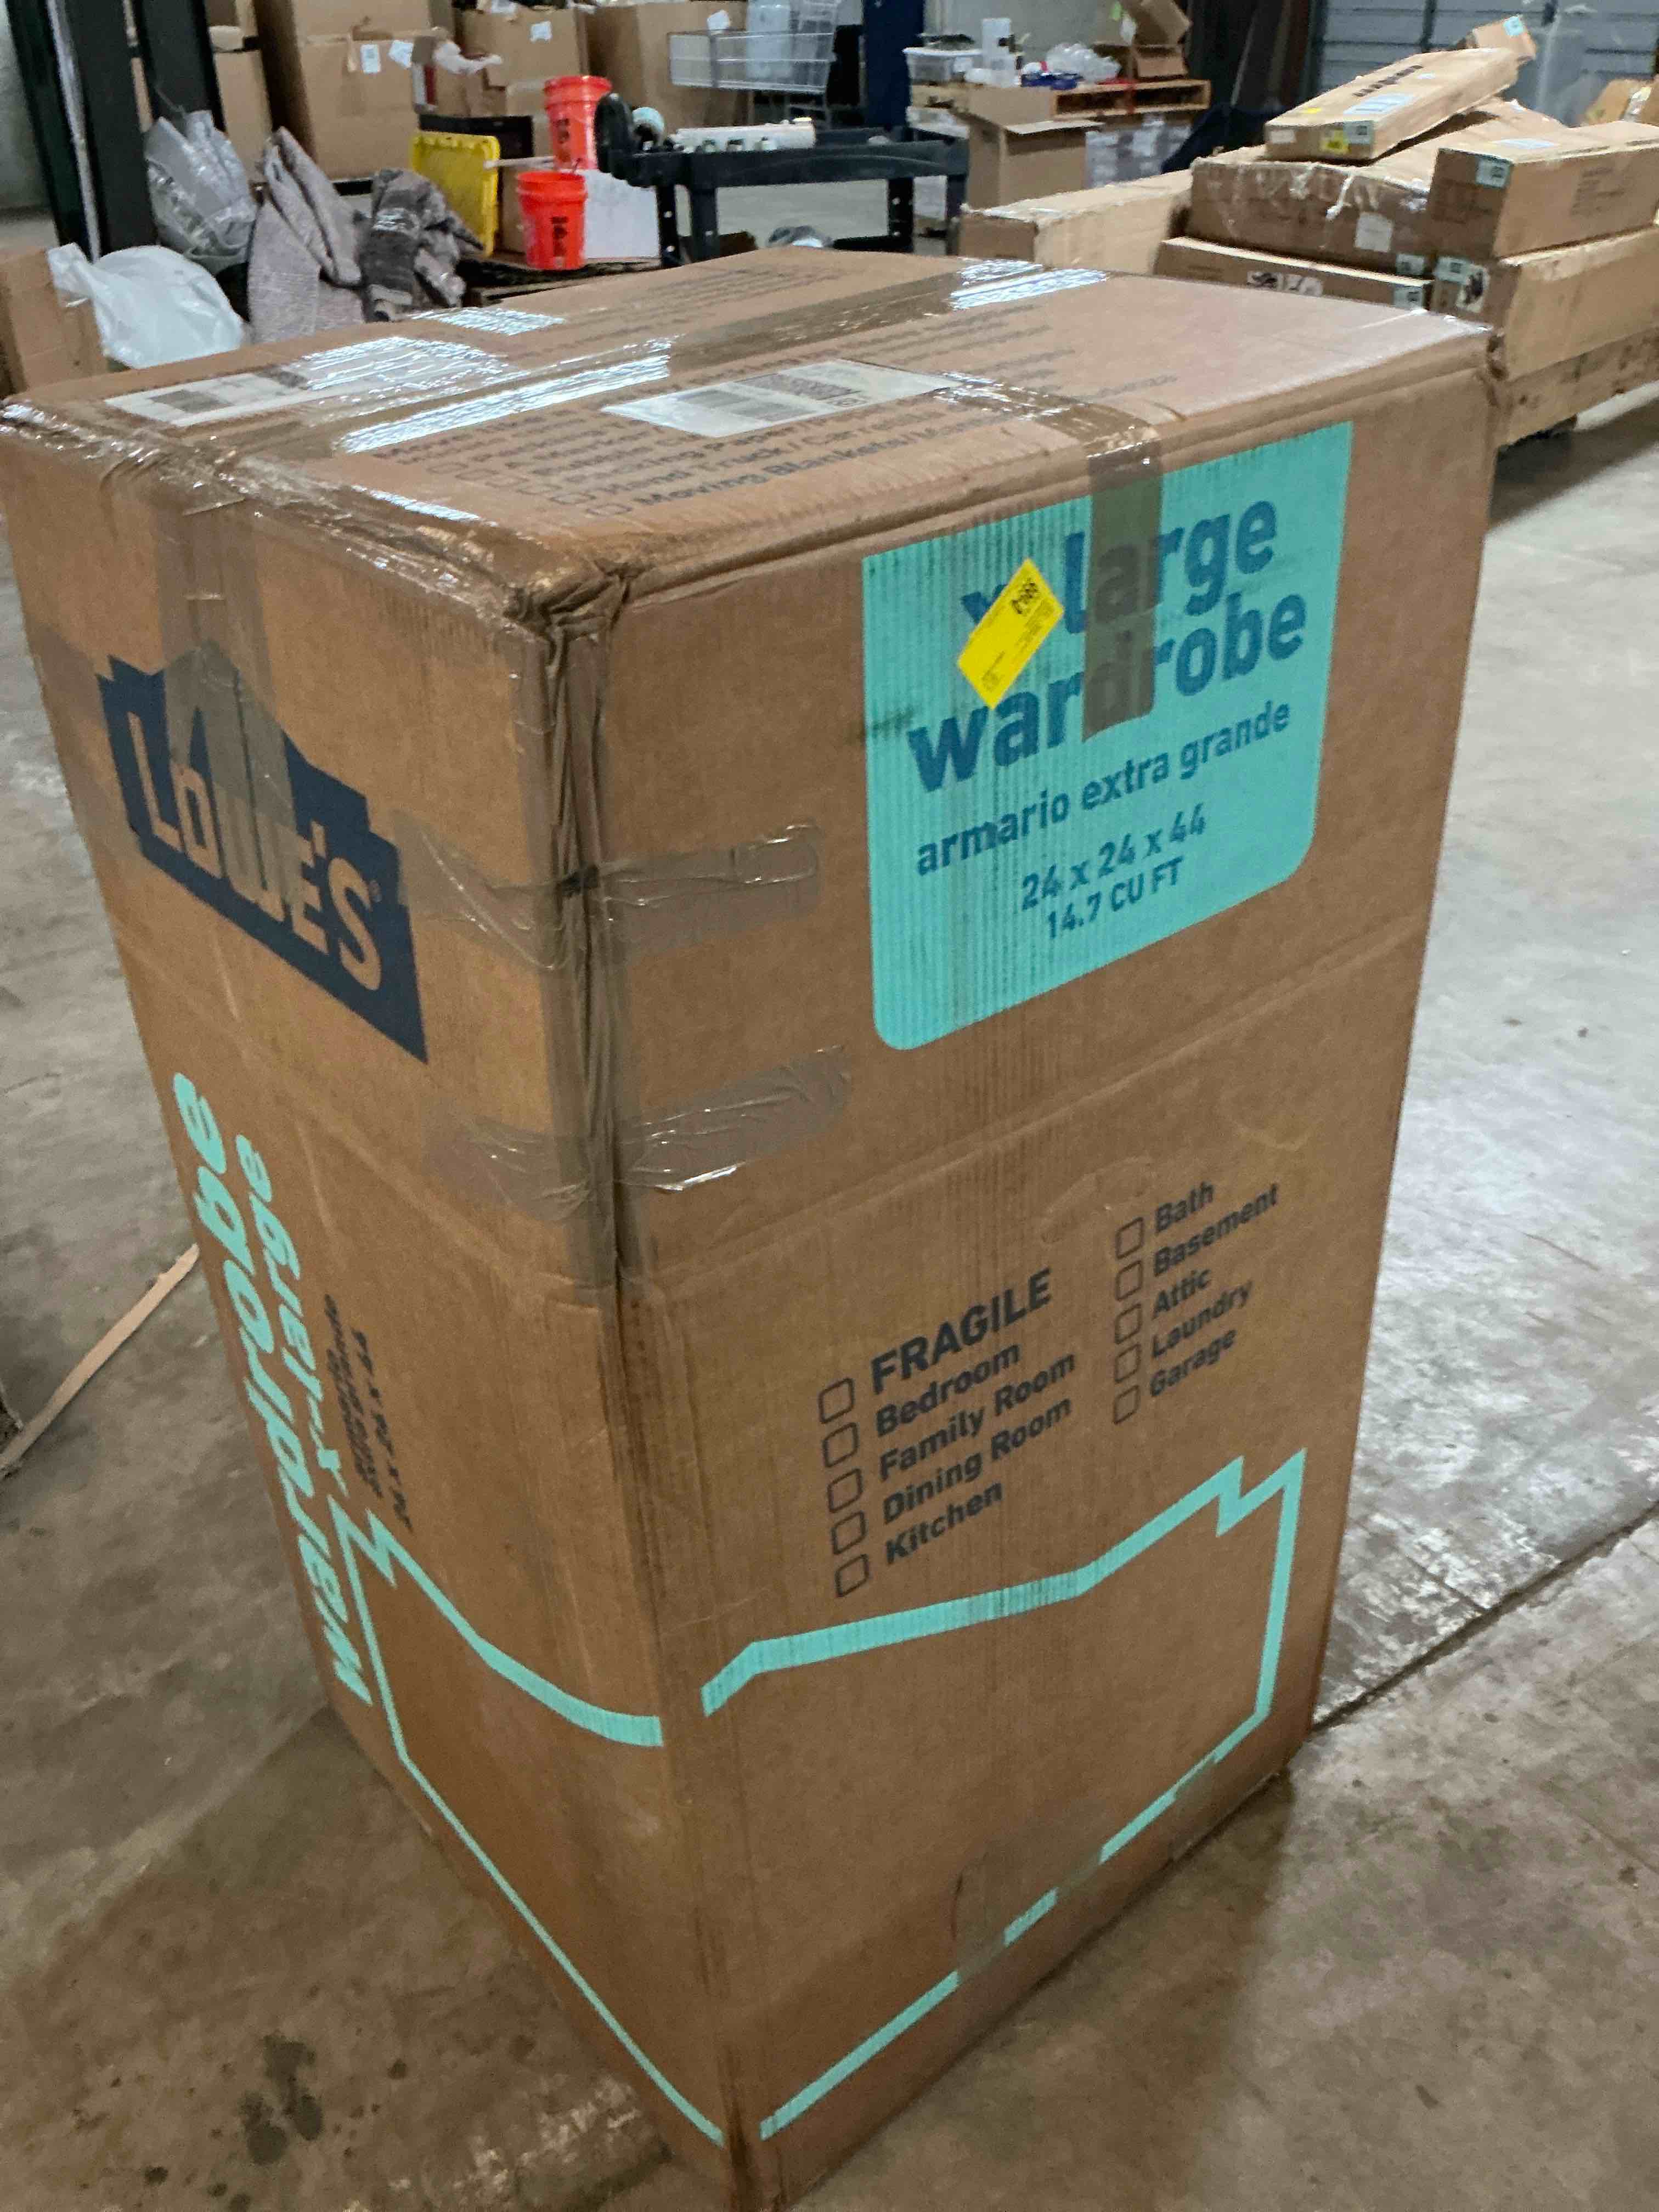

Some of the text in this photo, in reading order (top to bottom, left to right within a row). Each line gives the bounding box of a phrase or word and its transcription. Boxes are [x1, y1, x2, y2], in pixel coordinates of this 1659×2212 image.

[632, 472, 769, 506] Moving
[917, 699, 1291, 876] armario extra grande
[1020, 803, 1206, 912] 24 x 24 x 44
[1046, 855, 1184, 940] 14.7 CU FT
[1154, 1183, 1279, 1278] Basement
[1155, 1181, 1215, 1236] Bath
[870, 1267, 1052, 1395] FRAGILE
[1152, 1267, 1211, 1322] Attic
[1152, 1279, 1254, 1359] Laundry
[173, 1071, 373, 1706] wardrobe
[876, 1344, 1021, 1437] Bedroom
[1149, 1329, 1238, 1397] Garage
[879, 1353, 1076, 1482] Family Room
[883, 1397, 1072, 1525] Dining Room
[885, 1482, 1003, 1565] Kitchen
